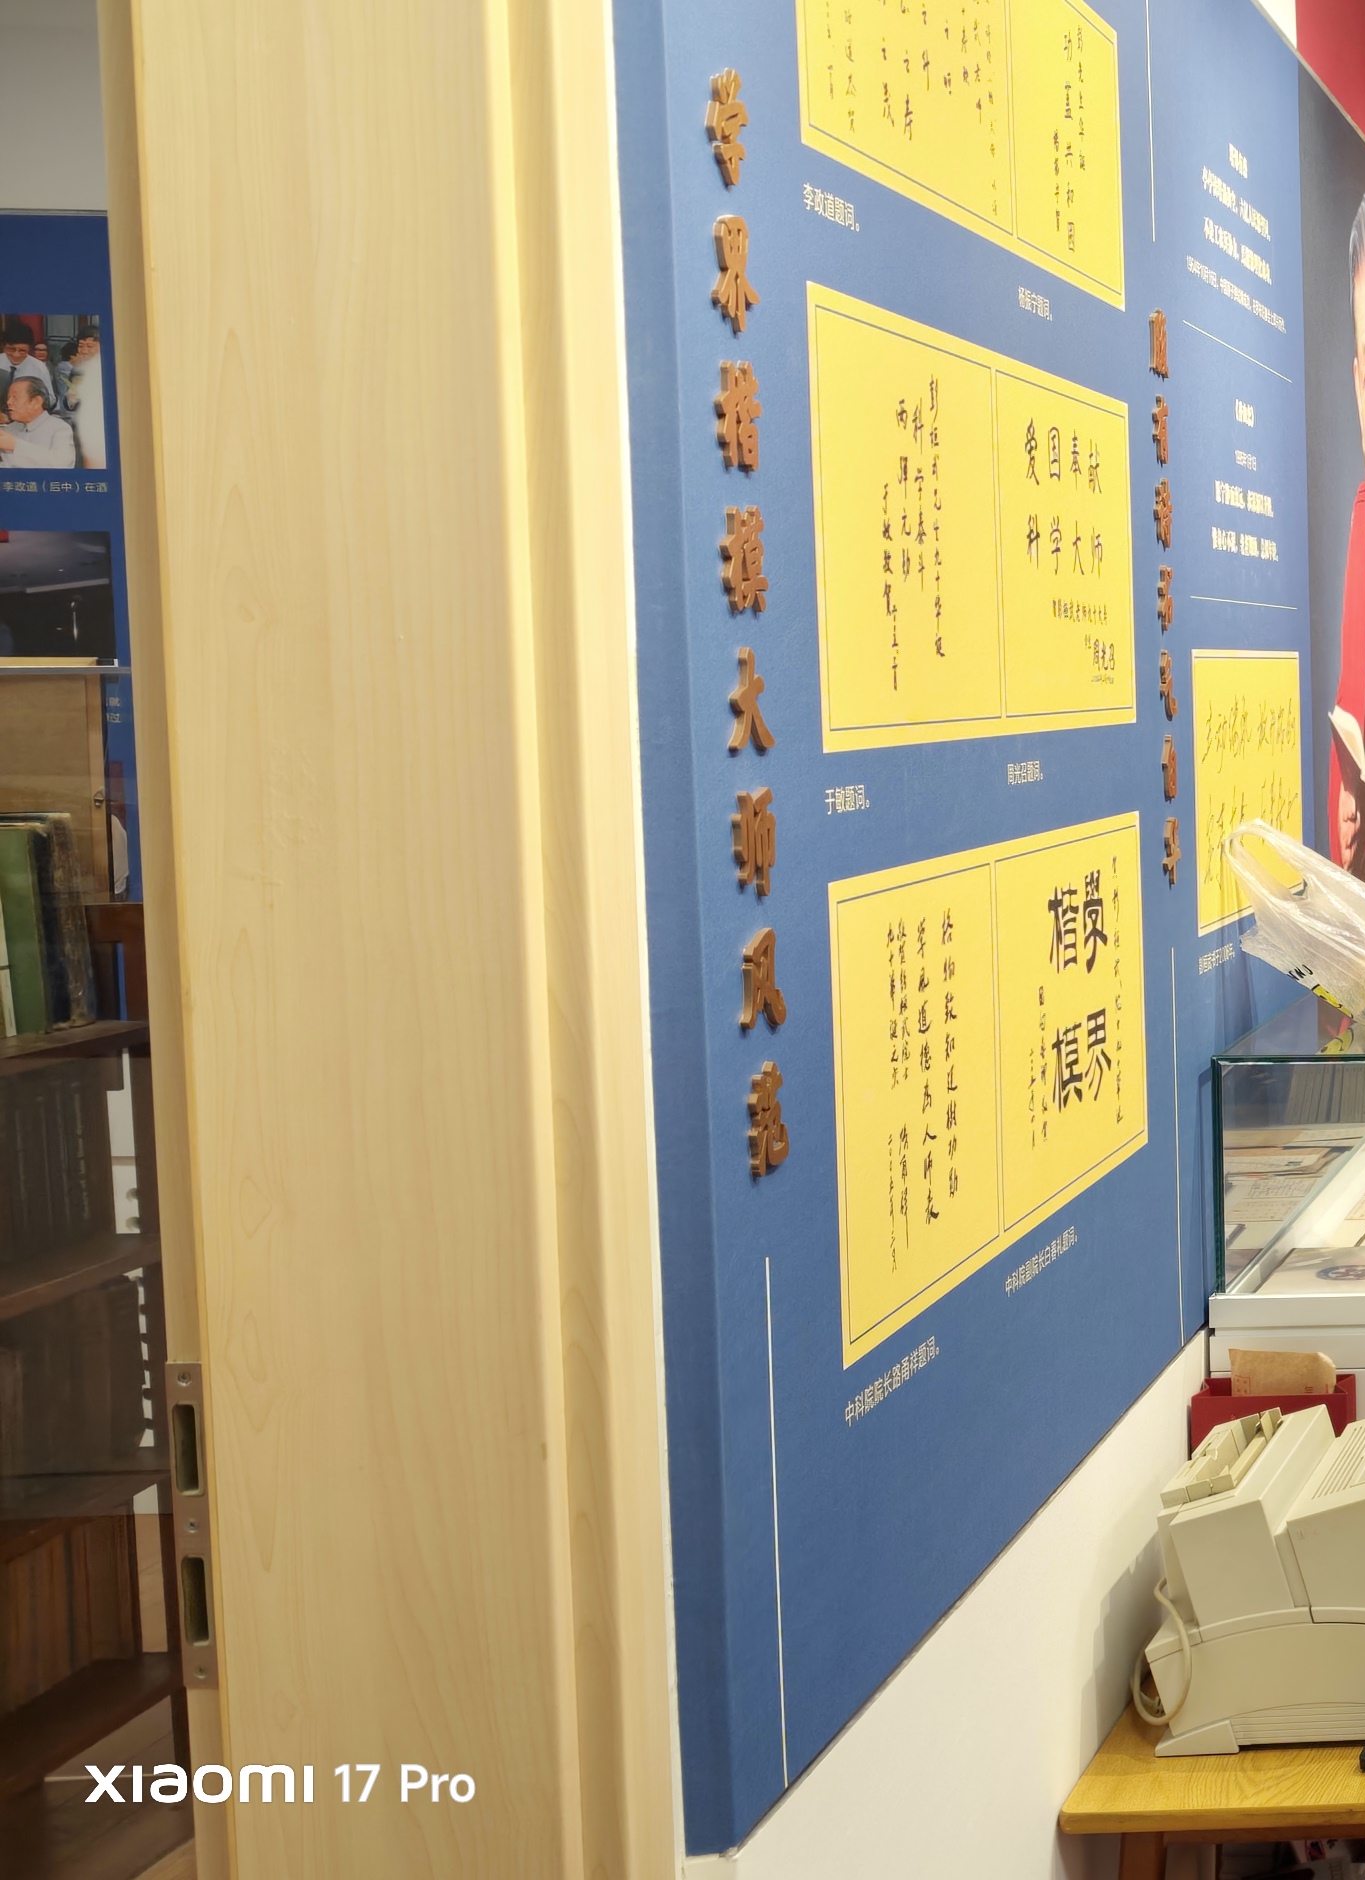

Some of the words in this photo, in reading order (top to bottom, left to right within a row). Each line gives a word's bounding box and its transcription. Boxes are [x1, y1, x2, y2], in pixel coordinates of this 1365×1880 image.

[803, 182, 860, 232] 李政道题词。
[1007, 761, 1043, 786] 周光召题词。
[825, 785, 870, 816] 于敏题词。
[845, 1334, 940, 1428] 中科院院长路甬祥题词。
